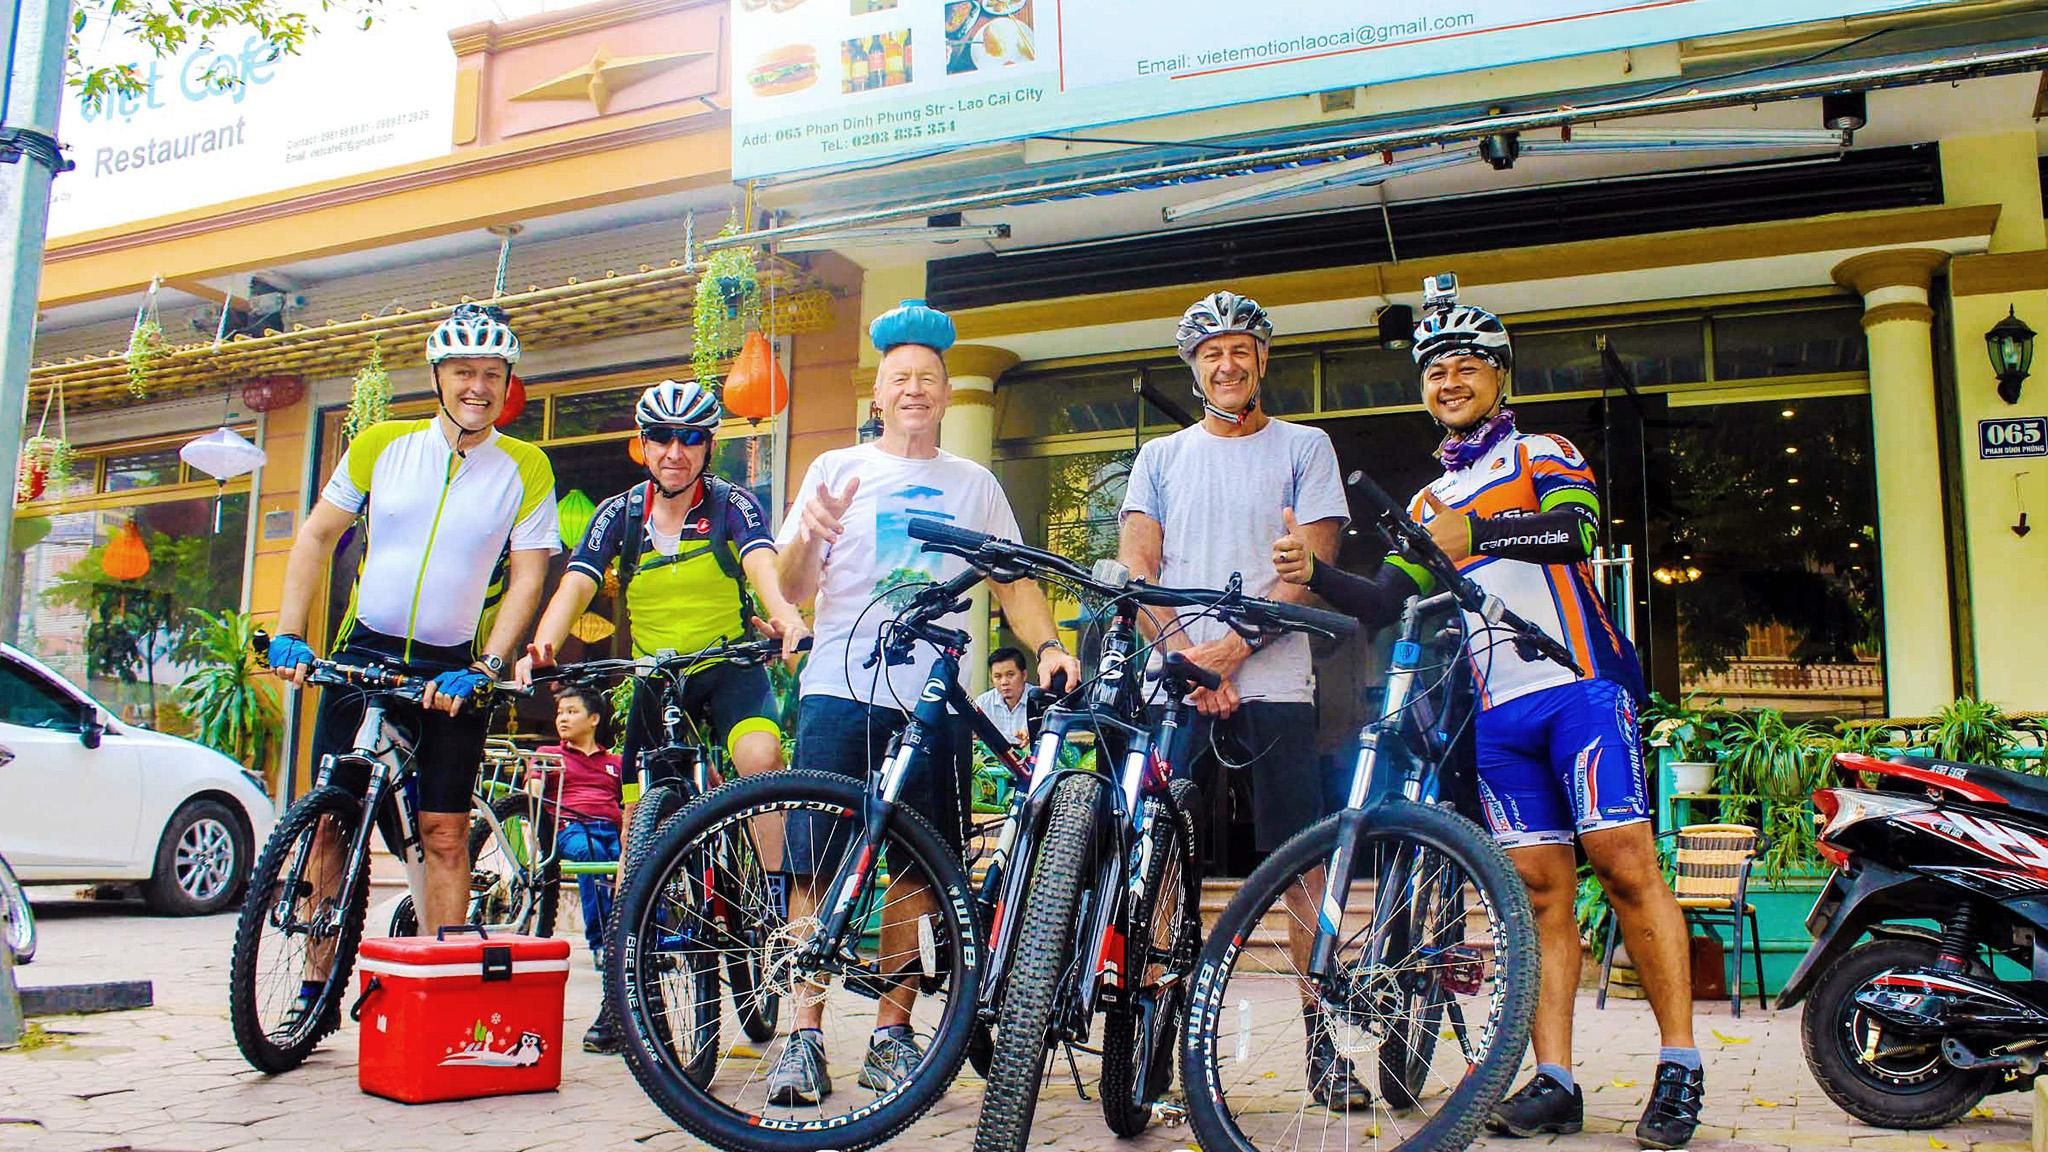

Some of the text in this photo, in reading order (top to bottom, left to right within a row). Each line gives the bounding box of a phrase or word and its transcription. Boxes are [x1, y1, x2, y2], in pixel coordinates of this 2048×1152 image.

[1136, 12, 1475, 75] Email: vietemotionlaocai@gmail.com
[742, 134, 772, 148] Add:
[776, 127, 802, 140] 065
[806, 121, 839, 137] Phan
[843, 116, 873, 131] Dinh
[877, 109, 922, 127] Phung
[925, 103, 946, 118] Str
[958, 97, 984, 112] Lao
[988, 92, 1011, 106] Cai
[1015, 88, 1044, 103] City
[852, 132, 890, 148] 0203
[894, 125, 923, 140] 835
[927, 120, 957, 135] 354
[94, 115, 247, 178] Restaurant
[1987, 422, 2041, 446] 065
[1479, 529, 1570, 551] cannondale
[1629, 745, 1644, 801] GAZPROM
[624, 934, 637, 969] BEE
[952, 898, 976, 967] WTB
[624, 972, 639, 1009] LINE
[1188, 962, 1215, 1034] WTB
